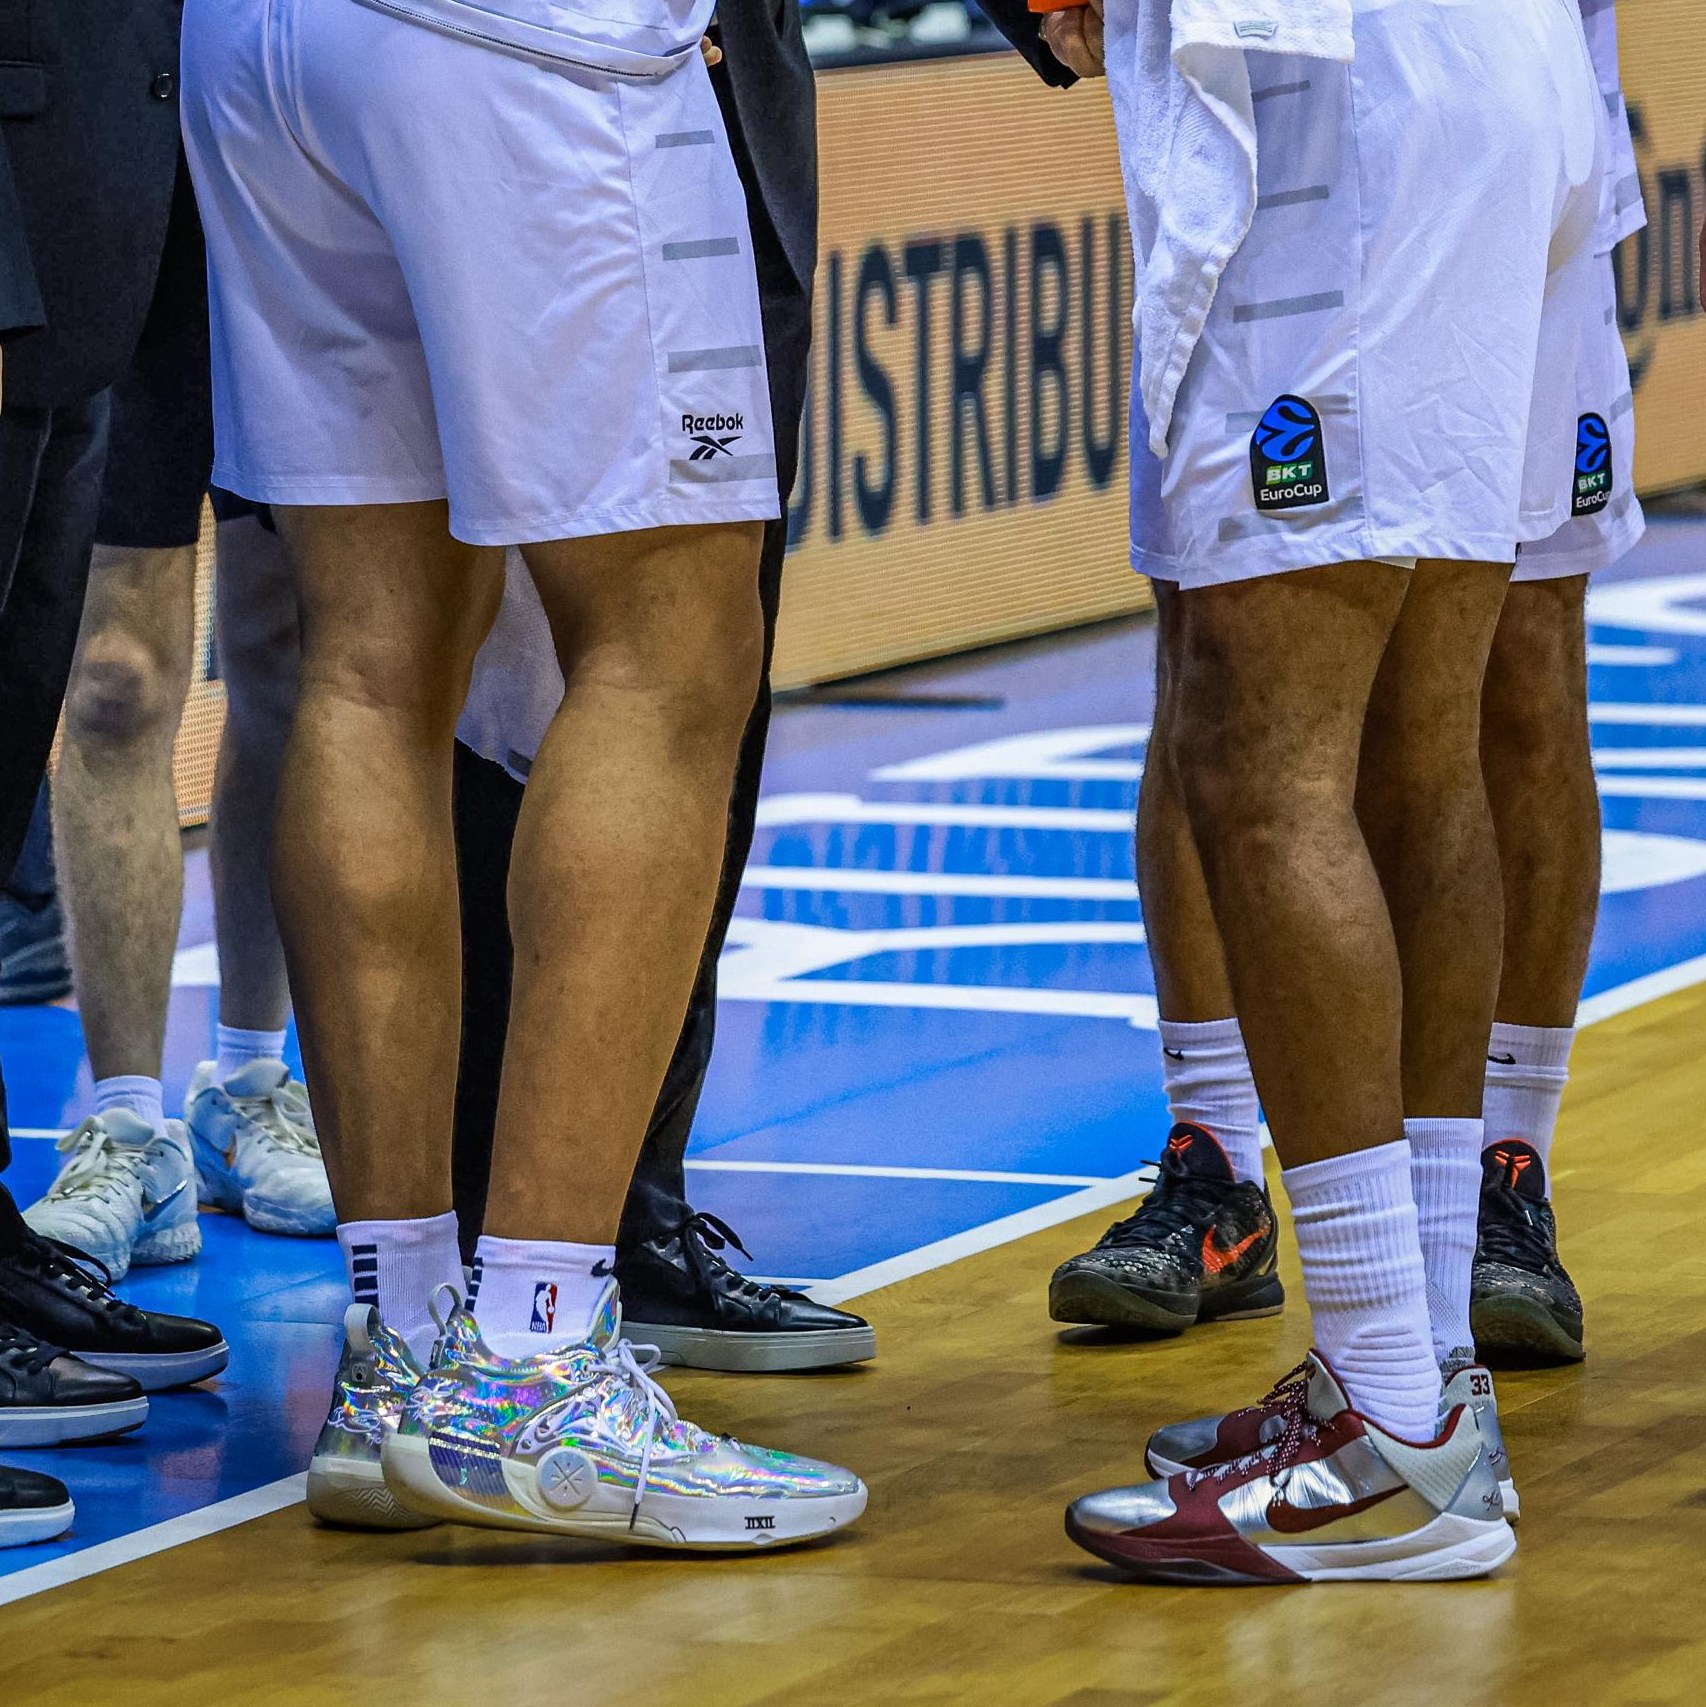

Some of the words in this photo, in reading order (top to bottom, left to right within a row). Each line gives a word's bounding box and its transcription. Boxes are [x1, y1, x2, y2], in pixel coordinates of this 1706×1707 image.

[682, 413, 744, 435] Reebok
[1267, 463, 1312, 483] BKT
[1577, 473, 1606, 490] BKT
[1260, 483, 1323, 501] EuroCup
